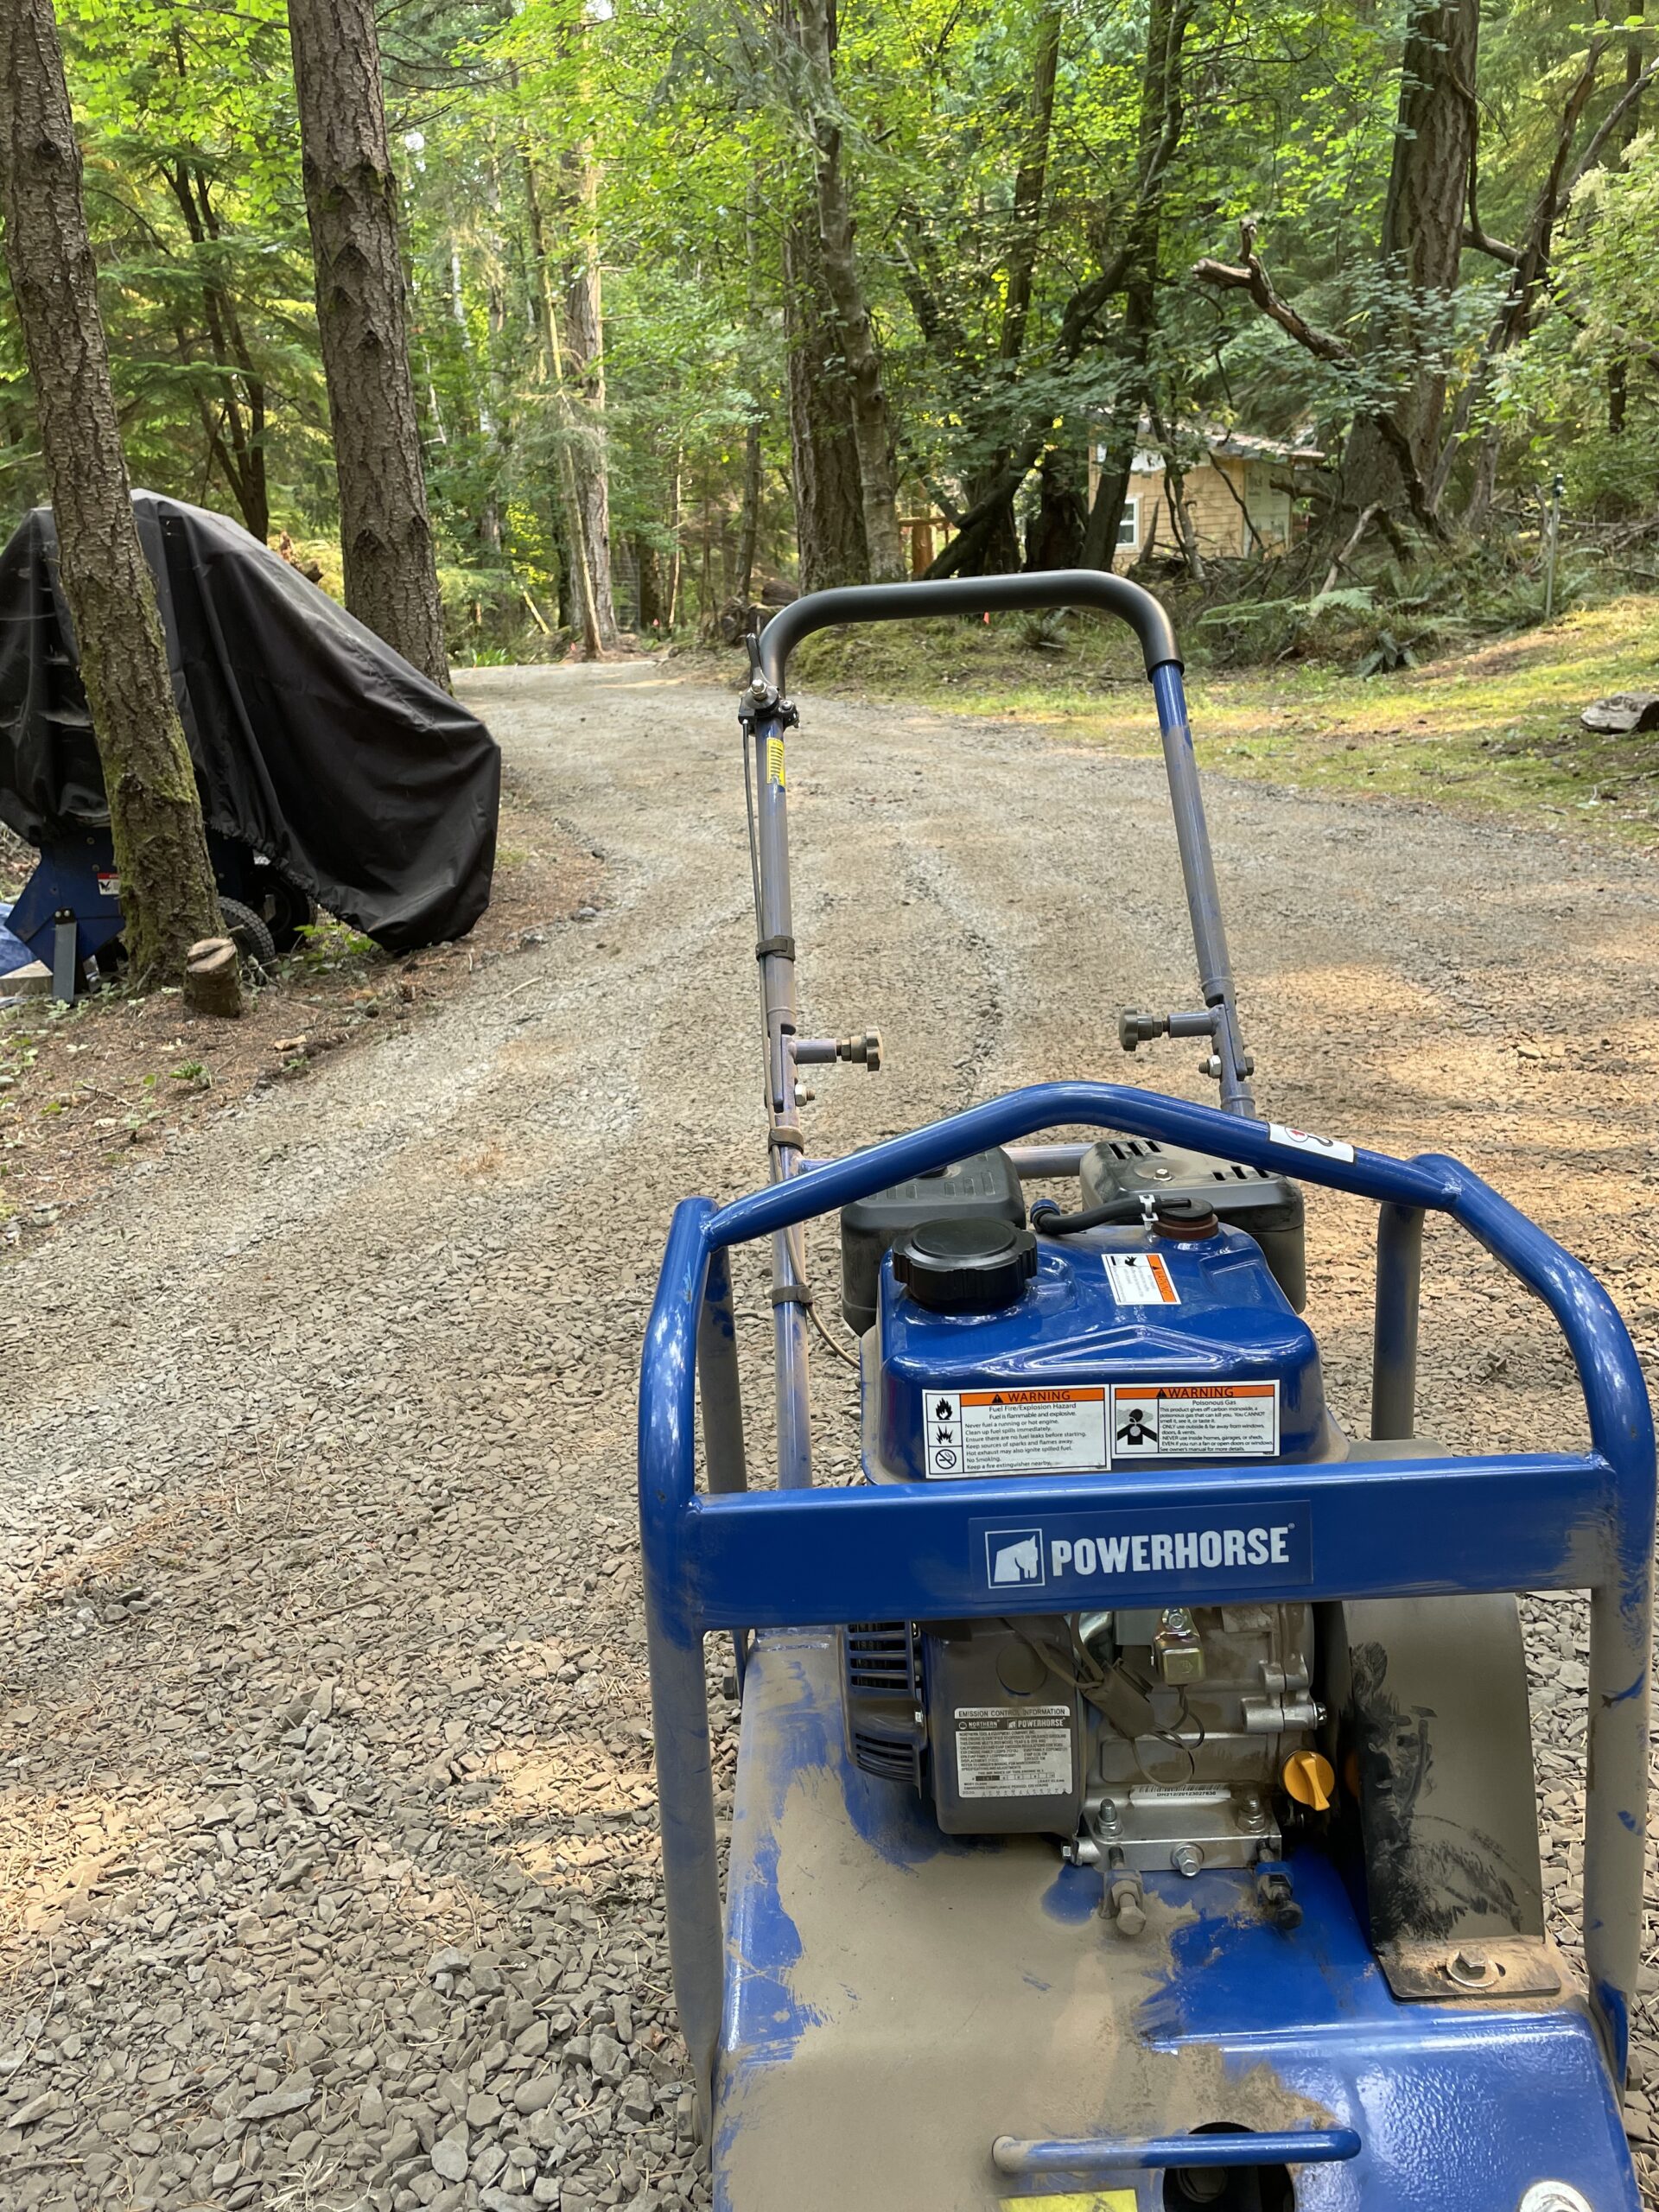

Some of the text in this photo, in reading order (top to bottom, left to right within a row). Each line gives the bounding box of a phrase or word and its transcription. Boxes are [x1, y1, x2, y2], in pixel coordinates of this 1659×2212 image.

[1007, 1390, 1071, 1402] WARNING
[1168, 1387, 1234, 1398] WARNING
[1005, 1403, 1052, 1413] Fire/Explosion
[1051, 1527, 1290, 1577] POWERHORSE
[1018, 1719, 1064, 1728] POWERHORSE
